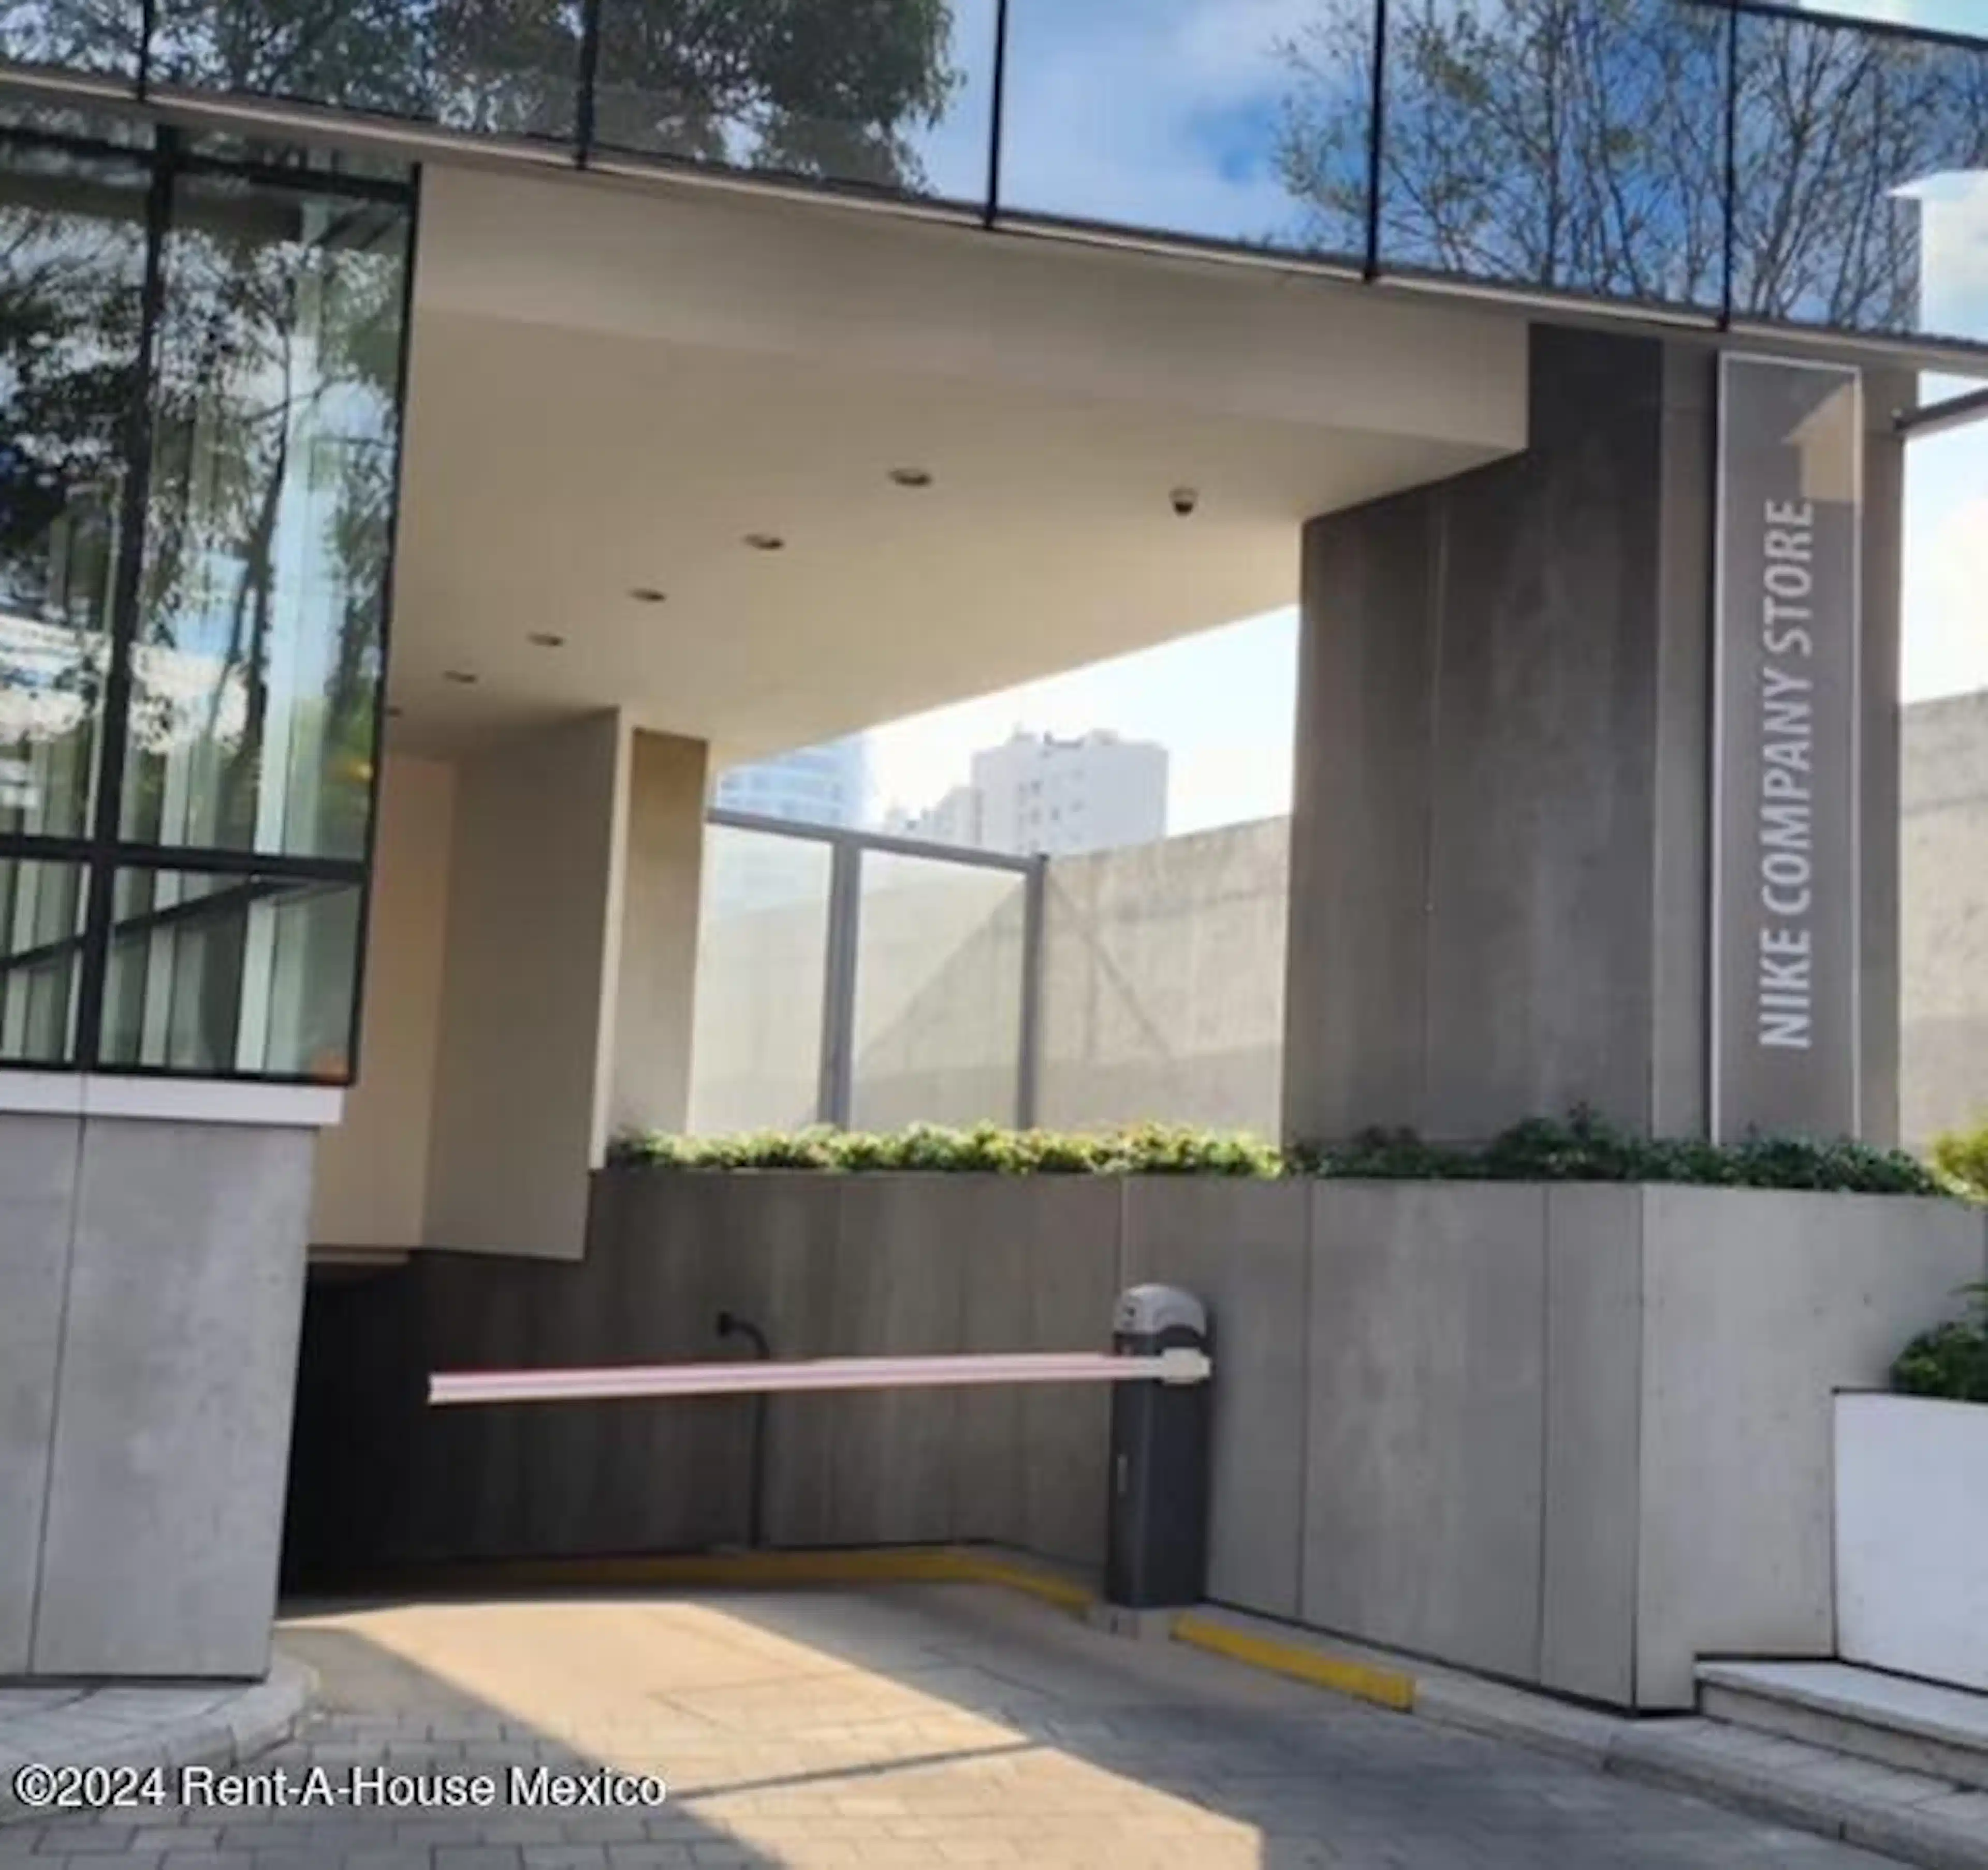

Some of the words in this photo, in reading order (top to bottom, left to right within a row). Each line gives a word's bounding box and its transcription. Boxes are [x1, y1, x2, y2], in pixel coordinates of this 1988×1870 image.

[1763, 498, 1814, 656] STORE
[1761, 667, 1812, 916] COMPANY
[1758, 927, 1812, 1050] NIKE
